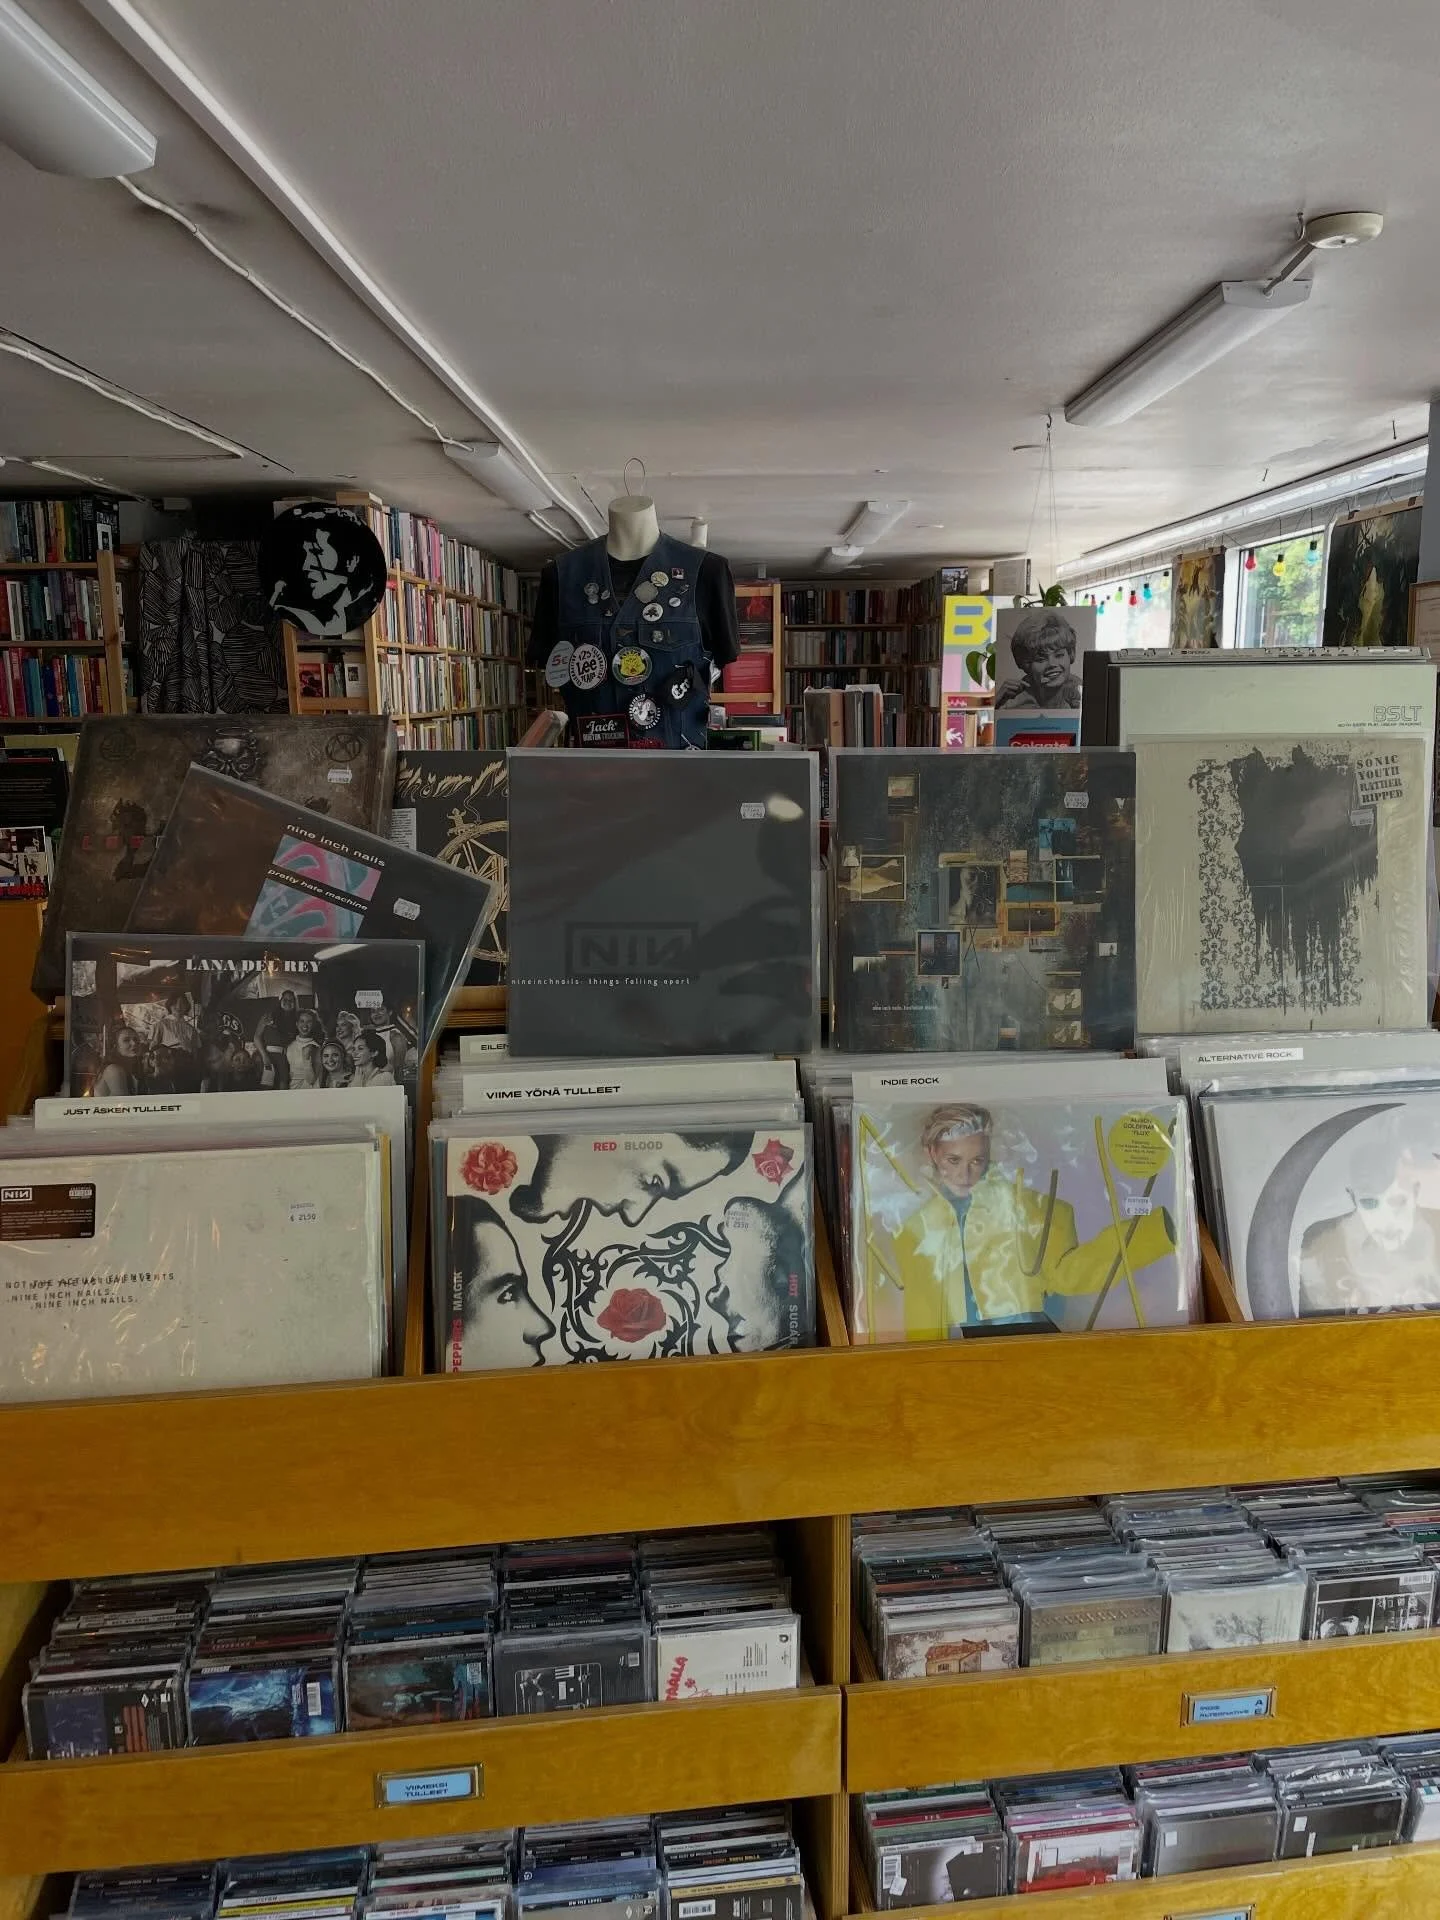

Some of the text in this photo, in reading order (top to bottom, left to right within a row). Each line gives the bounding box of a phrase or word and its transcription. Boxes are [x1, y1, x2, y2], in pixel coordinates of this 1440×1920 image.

[576, 658, 597, 676] Lee
[1374, 705, 1422, 721] BSLT
[586, 719, 617, 735] Jack
[1356, 754, 1398, 770] SONIC
[1358, 766, 1400, 780] YOUTH
[1359, 778, 1402, 792] RATHER
[1361, 789, 1403, 803] RIPPED
[286, 824, 386, 868] nine inch nails
[267, 868, 368, 911] pretty hate machine
[185, 959, 322, 973] LANA DEL REY
[588, 977, 620, 987] things
[625, 977, 658, 987] falling
[663, 977, 690, 987] apart
[1197, 1053, 1264, 1063] ALTERNATIVE
[880, 1077, 940, 1086] INDIE ROCK
[486, 1085, 621, 1100] VIIME YÖNÄ TULLEET
[63, 1108, 91, 1116] JUST
[132, 1104, 182, 1113] TULLEET
[592, 1140, 663, 1151] RED BLOOD
[452, 1270, 463, 1311] MAGIK
[787, 1272, 799, 1297] HOT
[788, 1304, 799, 1345] SUGAR
[404, 1788, 448, 1797] TULLEET
